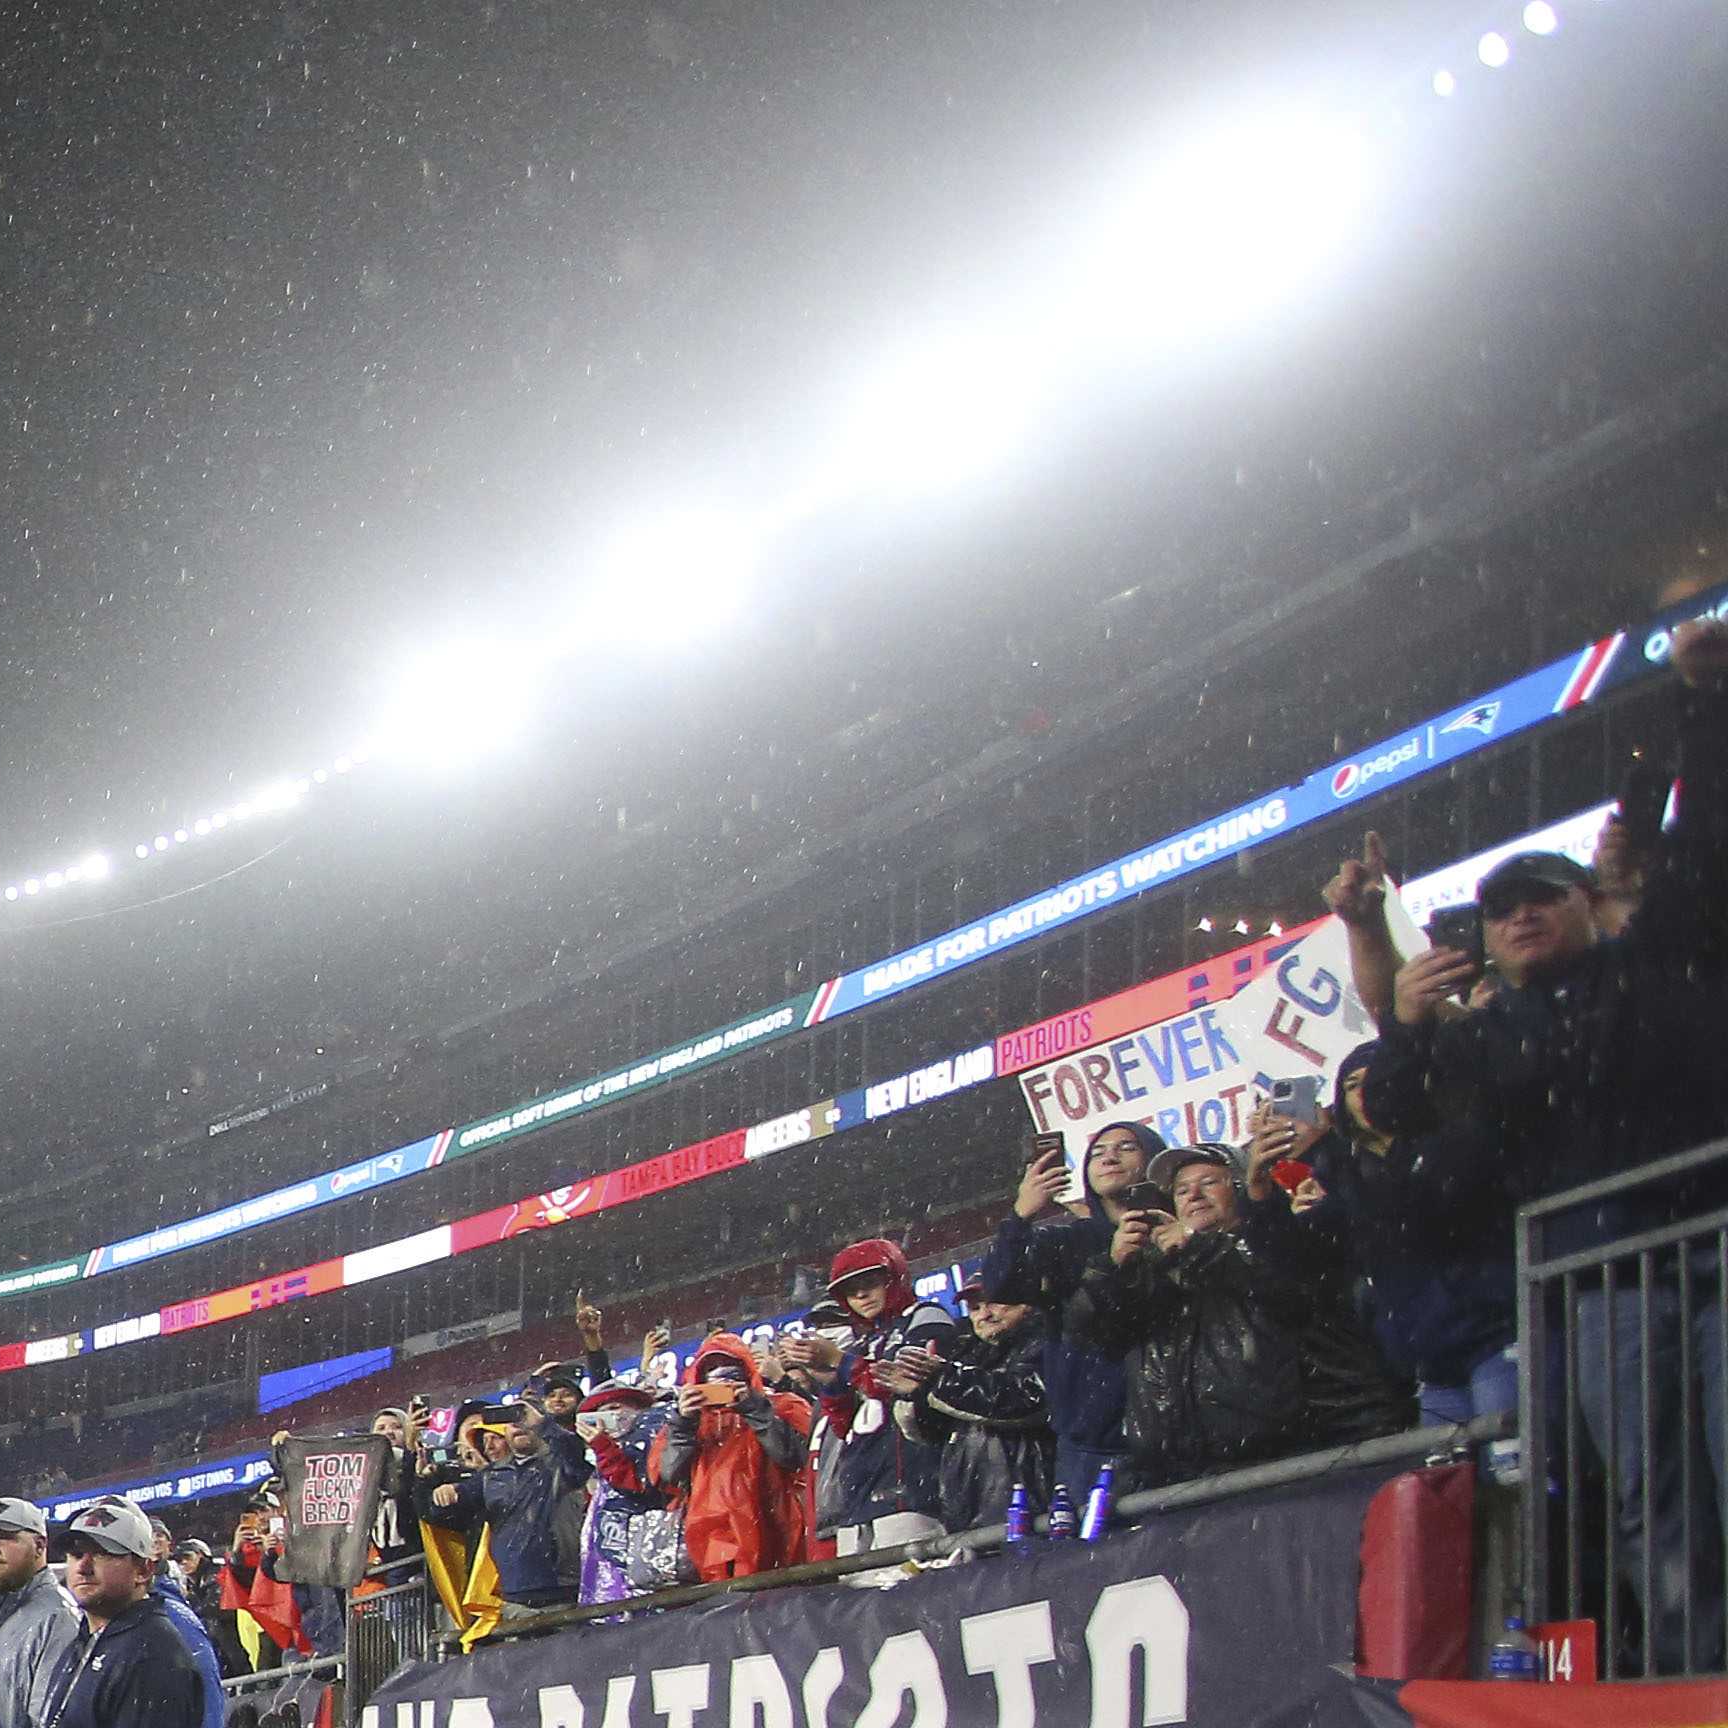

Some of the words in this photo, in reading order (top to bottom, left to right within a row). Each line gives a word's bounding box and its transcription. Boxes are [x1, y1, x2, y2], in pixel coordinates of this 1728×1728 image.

[1359, 738, 1420, 786] pepsi
[863, 948, 933, 997] MADE
[935, 928, 988, 967] FOR
[988, 870, 1119, 944] PATRIOTS
[1120, 797, 1287, 889] WATCHING
[511, 1103, 544, 1130] SOFT
[582, 1081, 603, 1102] OF
[601, 1070, 630, 1096] THE
[659, 1032, 724, 1074] ENGLAND
[723, 1007, 794, 1049] PATRIOTS
[865, 1076, 910, 1120] NEW
[1000, 1010, 1095, 1075] PATRIOTS
[1024, 1008, 1241, 1137] FOREVER
[619, 1159, 671, 1199] TAMPA
[672, 1147, 705, 1184] BAY
[306, 1453, 366, 1478] TOM
